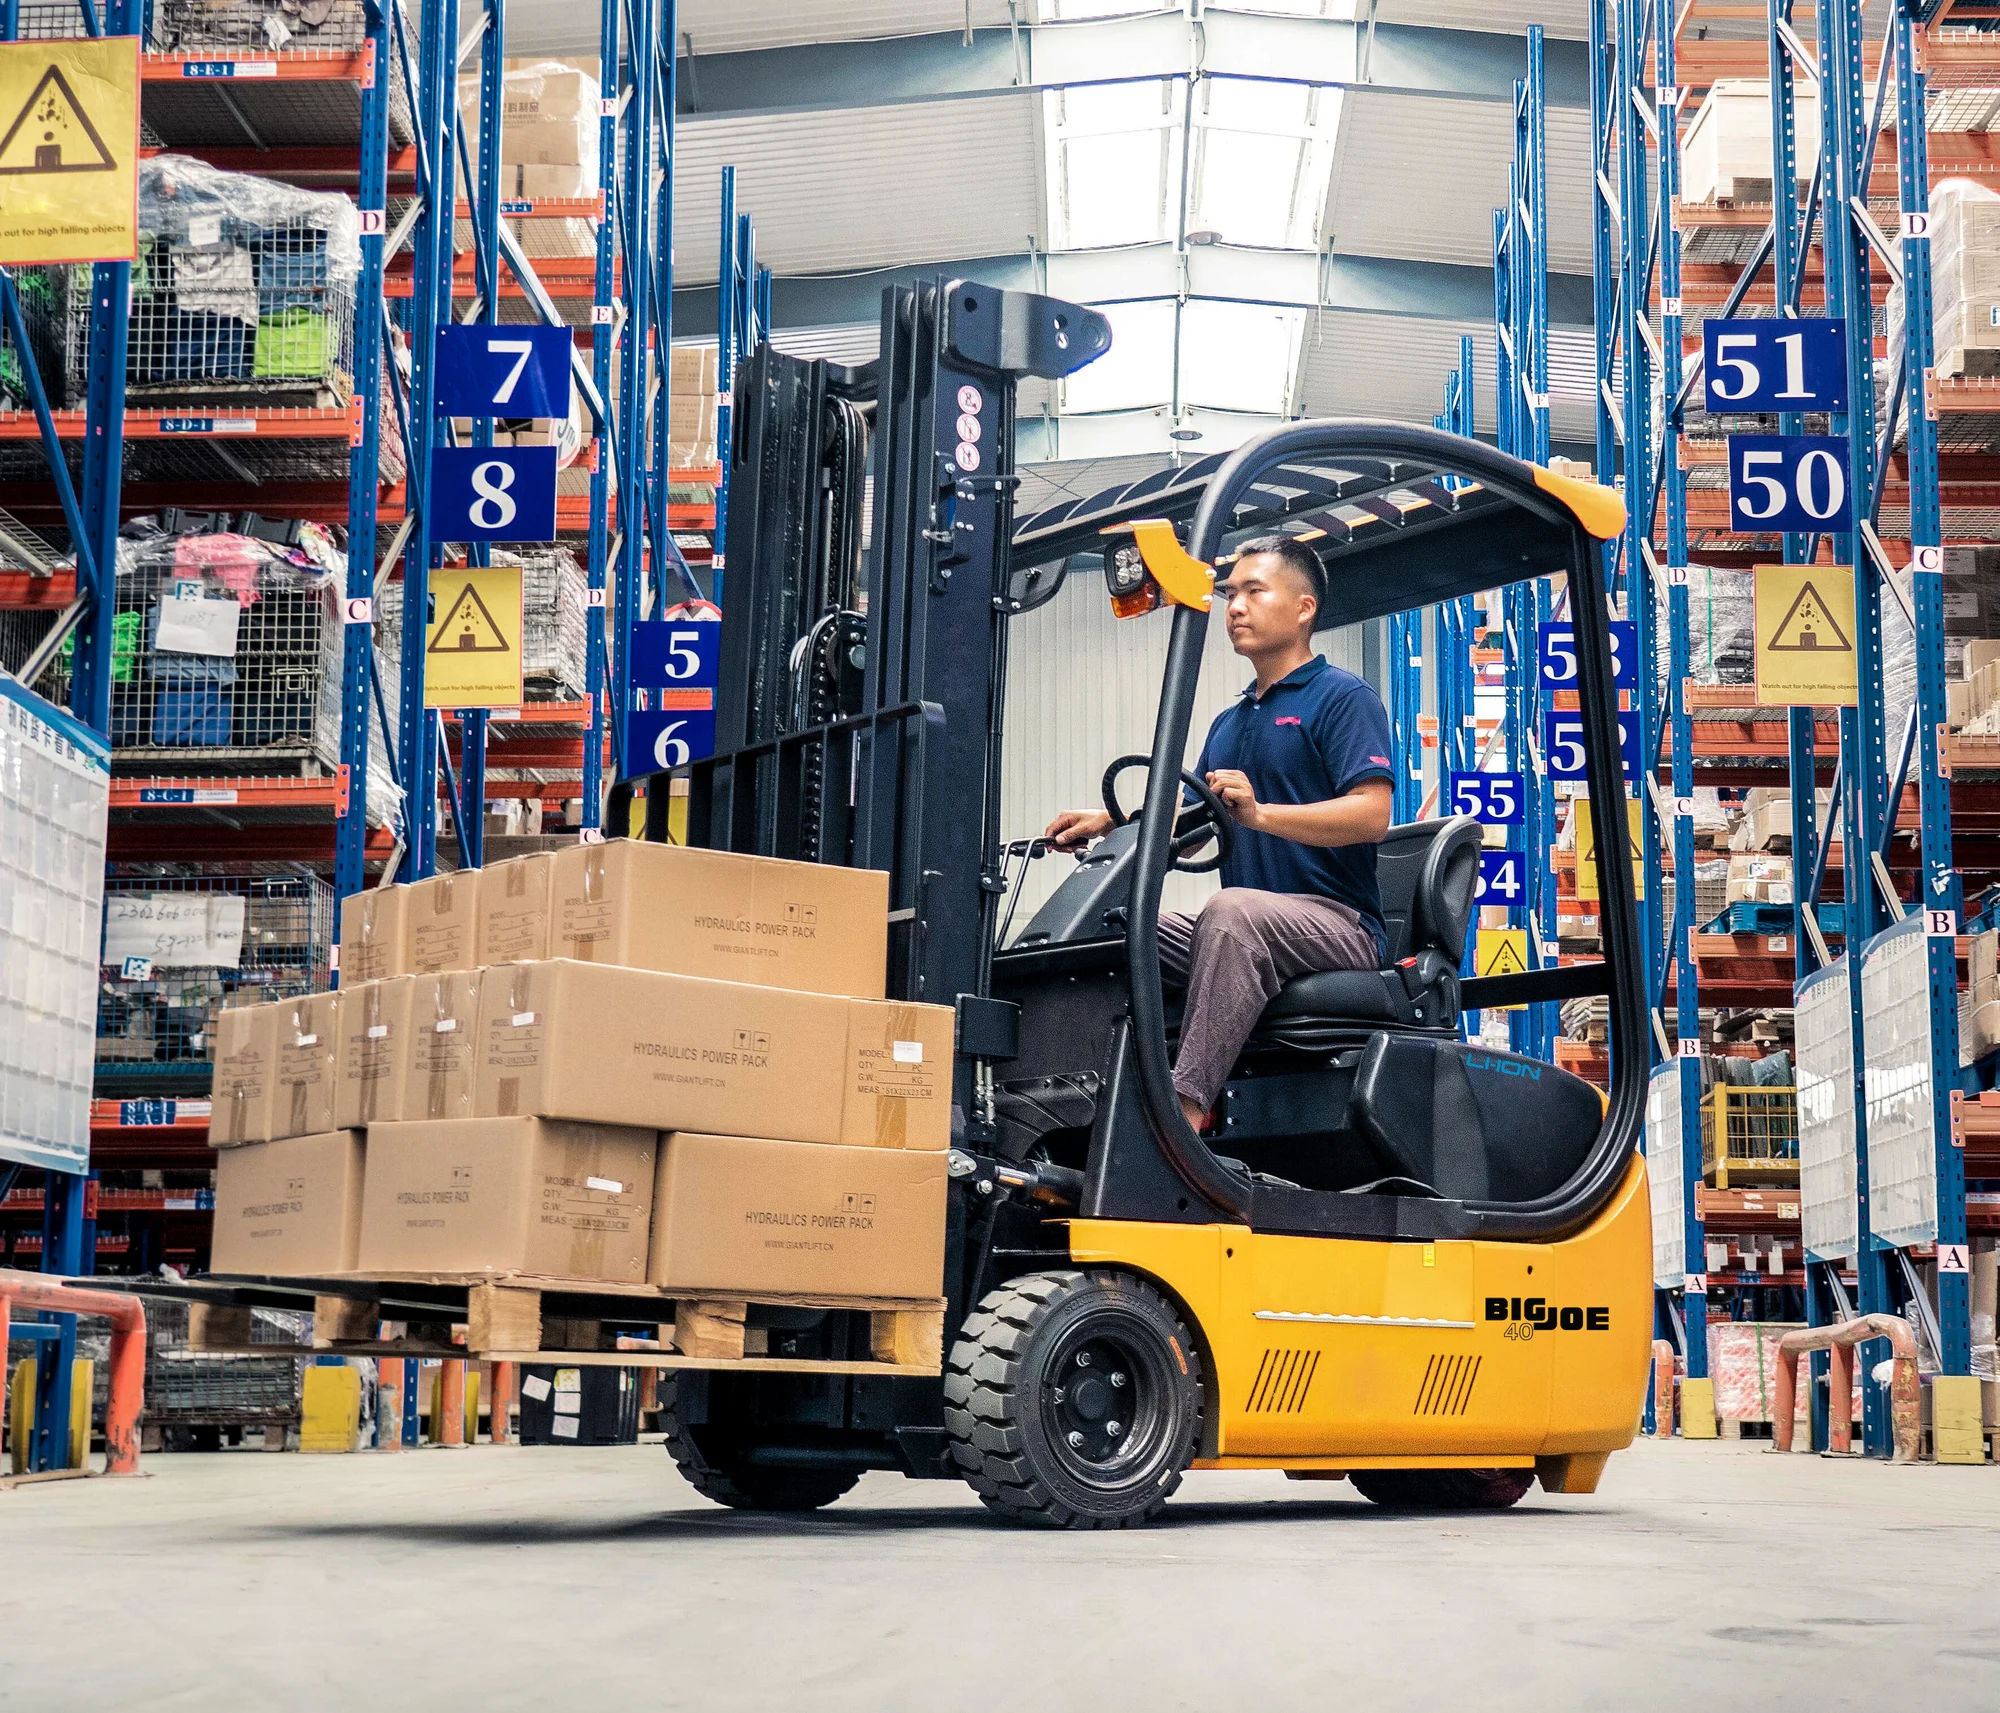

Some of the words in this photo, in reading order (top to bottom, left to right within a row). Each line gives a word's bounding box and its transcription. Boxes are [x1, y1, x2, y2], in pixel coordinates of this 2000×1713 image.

[189, 65, 229, 76] 8-E-1
[1661, 88, 1674, 102] F
[602, 100, 614, 114] F
[361, 212, 381, 232] D
[1907, 214, 1927, 235] D
[4, 229, 20, 237] out
[22, 228, 35, 237] for
[37, 227, 59, 238] high
[60, 225, 90, 237] falling
[91, 224, 127, 235] objects
[595, 307, 609, 322] E
[1665, 299, 1678, 314] E
[487, 340, 533, 404] 7
[1711, 333, 1817, 400] 51
[1536, 394, 1547, 408] F
[165, 419, 207, 431] 8-D-1
[1737, 450, 1845, 519] 50
[468, 461, 517, 529] 8
[1919, 548, 1939, 570] C
[1672, 568, 1688, 585] D
[589, 590, 602, 605] D
[348, 600, 367, 620] C
[664, 631, 701, 679] 5
[653, 720, 690, 769] 6
[146, 790, 187, 802] 8-C-1
[1453, 780, 1516, 818] 55
[1678, 799, 1691, 813] C
[584, 829, 598, 843] C
[694, 915, 751, 934] HYDRAULICS
[755, 922, 789, 937] POWER
[792, 926, 817, 940] PACK
[1930, 912, 1951, 934] B
[713, 943, 779, 958] WWW.GIANTLIFT.CN
[1545, 942, 1557, 954] C
[633, 1041, 697, 1061] HYDRAULICS
[702, 1050, 738, 1066] POWER
[741, 1054, 768, 1069] PACK
[1684, 1040, 1697, 1055] B
[912, 1065, 924, 1073] PC
[653, 1072, 726, 1088] WWW.GIANTLIFT.CN
[912, 1076, 924, 1085] KG
[607, 1195, 620, 1204] PC
[605, 1207, 620, 1216] KG
[745, 1211, 807, 1227] HYDRAULICS
[811, 1214, 846, 1229] POWER
[849, 1217, 874, 1230] PACK
[764, 1240, 834, 1251] WWW.GIANTLIFT.CN
[1942, 1246, 1966, 1269] A
[1689, 1275, 1703, 1291] A
[1485, 1297, 1546, 1321] BIG
[1533, 1307, 1609, 1331] JOE
[1503, 1322, 1534, 1341] 40
